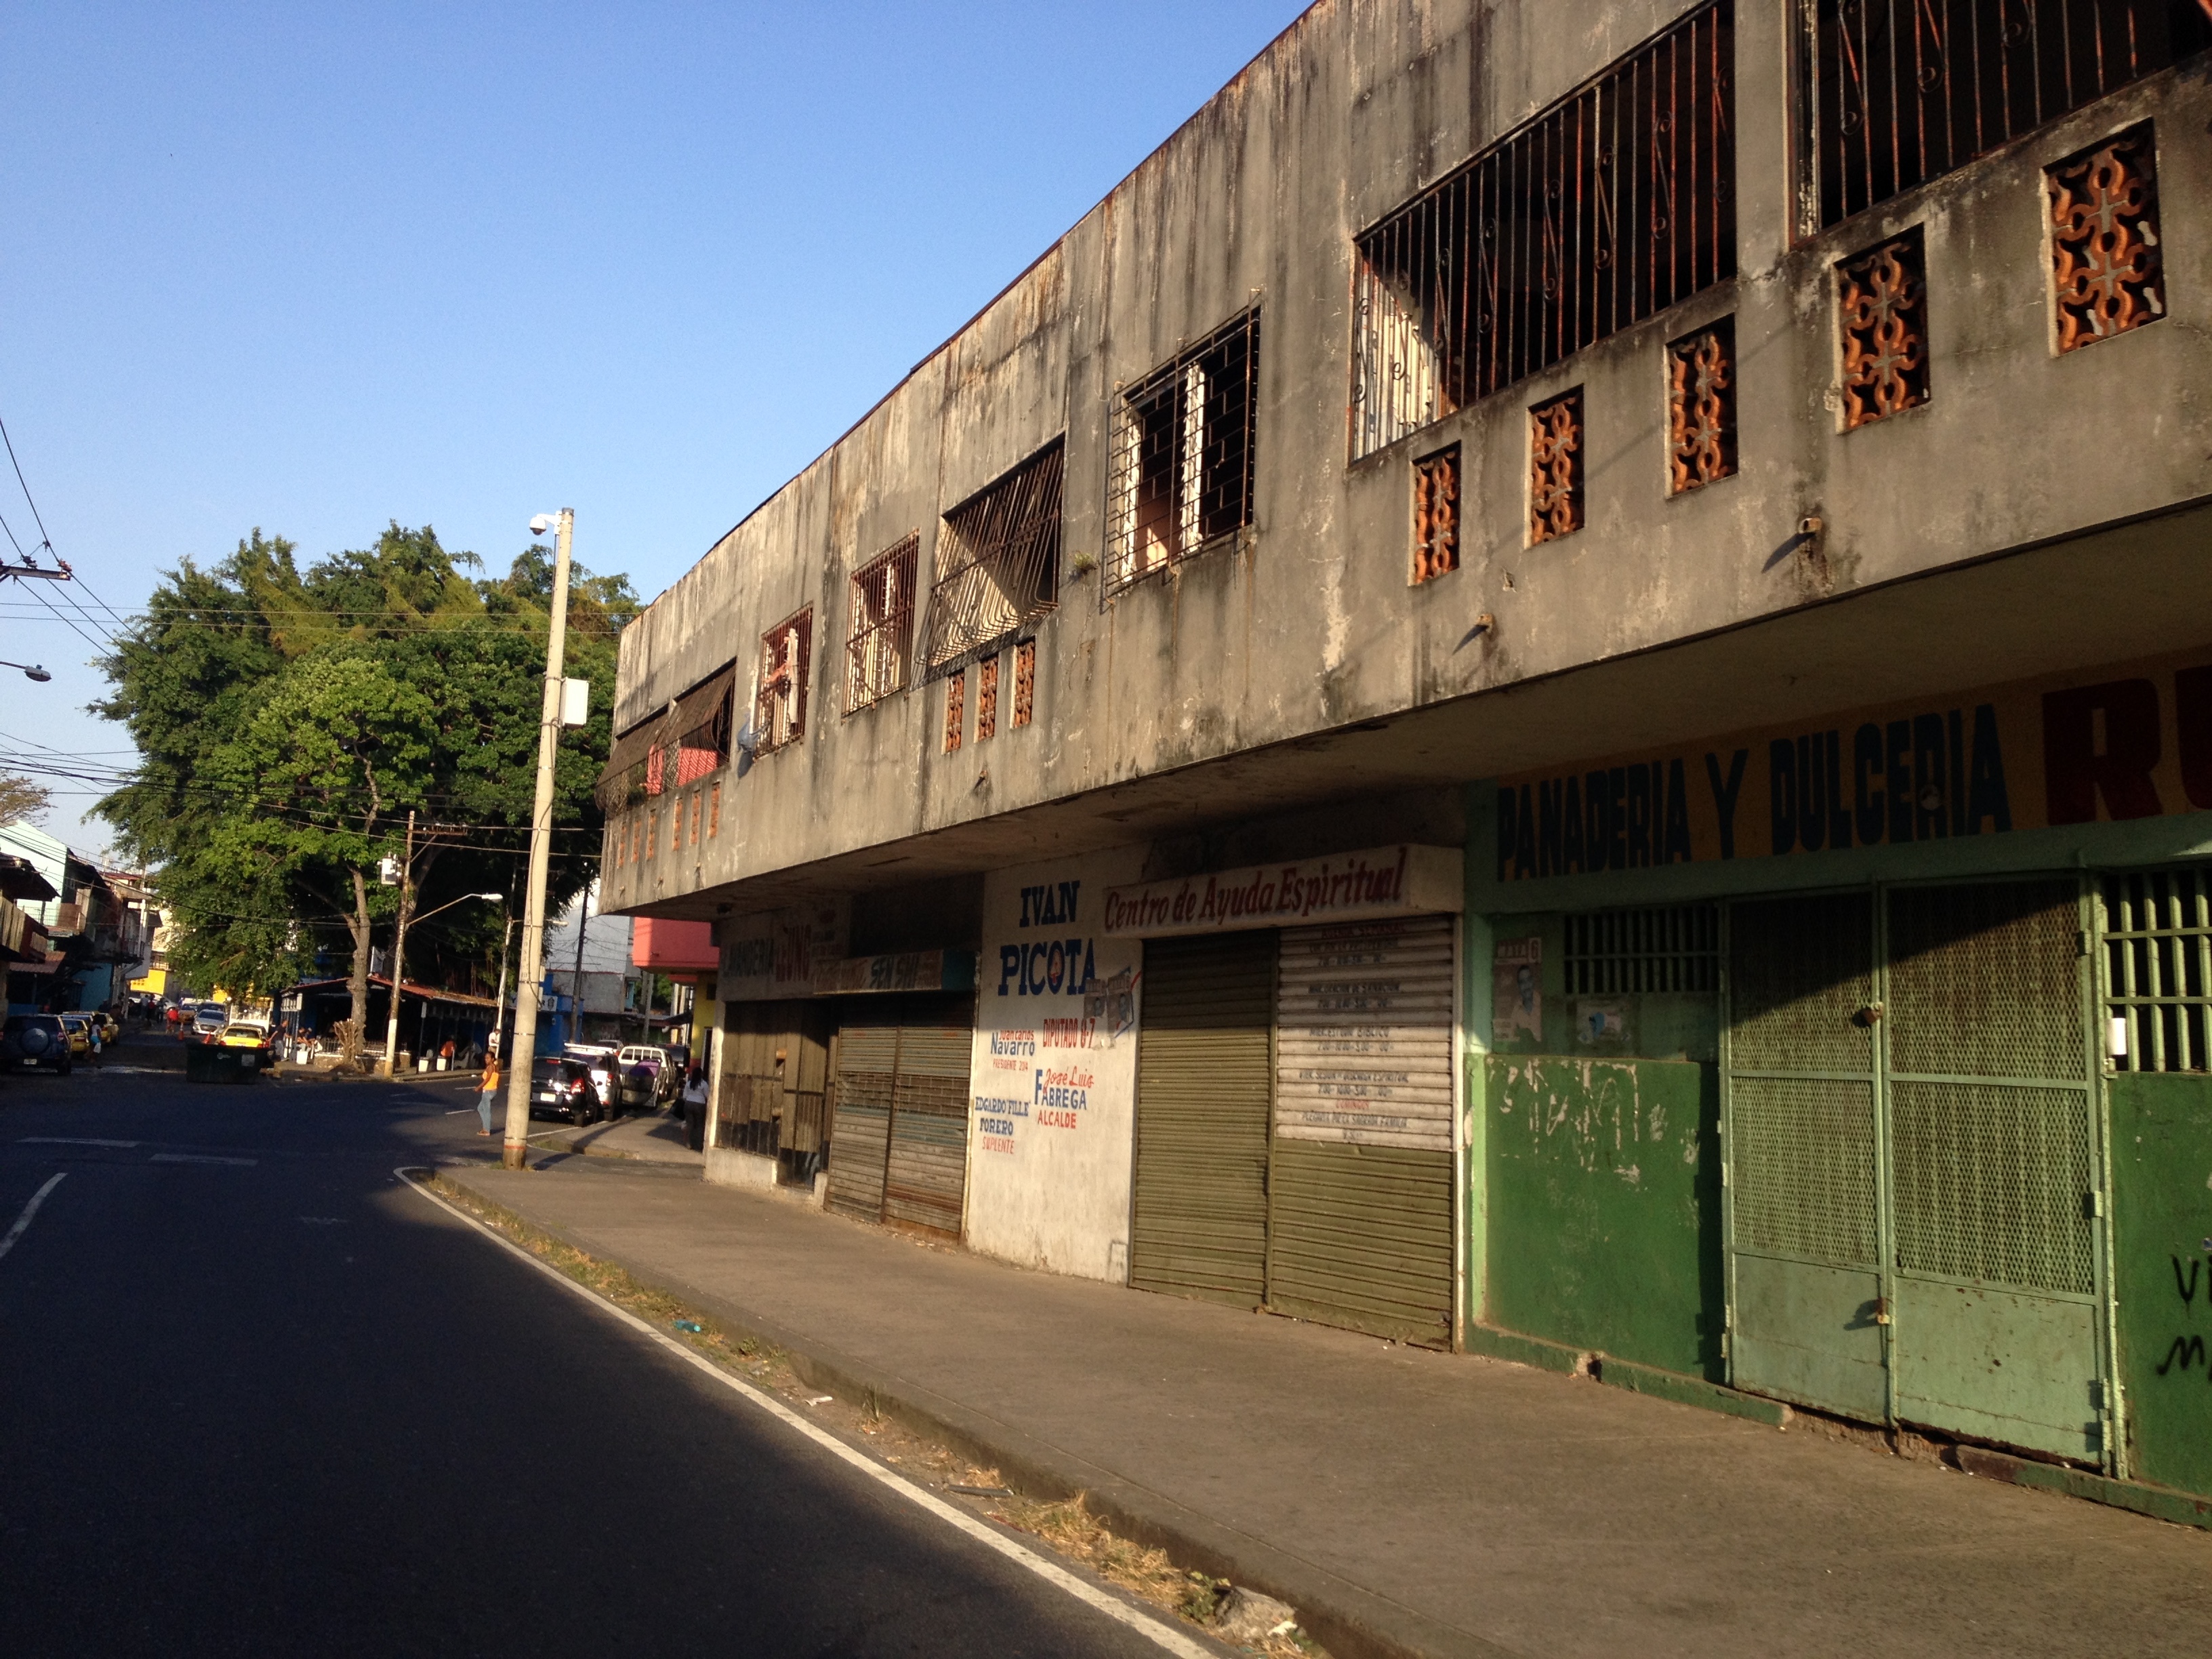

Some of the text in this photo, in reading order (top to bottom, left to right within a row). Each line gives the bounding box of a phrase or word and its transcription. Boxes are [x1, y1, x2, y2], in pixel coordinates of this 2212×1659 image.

[1497, 758, 1692, 884] PANADERIA
[1704, 748, 1749, 860] Y
[1769, 703, 2013, 856] DULCERIA
[1019, 880, 1080, 928] IVAN
[1105, 846, 1408, 932] Centro de Ayuda Espiritual
[998, 937, 1095, 996] PICOTA
[990, 1031, 1035, 1057] Navarro
[1042, 1017, 1079, 1048] DIPUTADO
[1034, 1069, 1087, 1111] FABREGA
[1069, 1065, 1094, 1089] Luis
[975, 1096, 1006, 1114] EDGARDO
[1038, 1109, 1077, 1129] ALCALDE
[982, 1136, 1015, 1155] SUPLENTE
